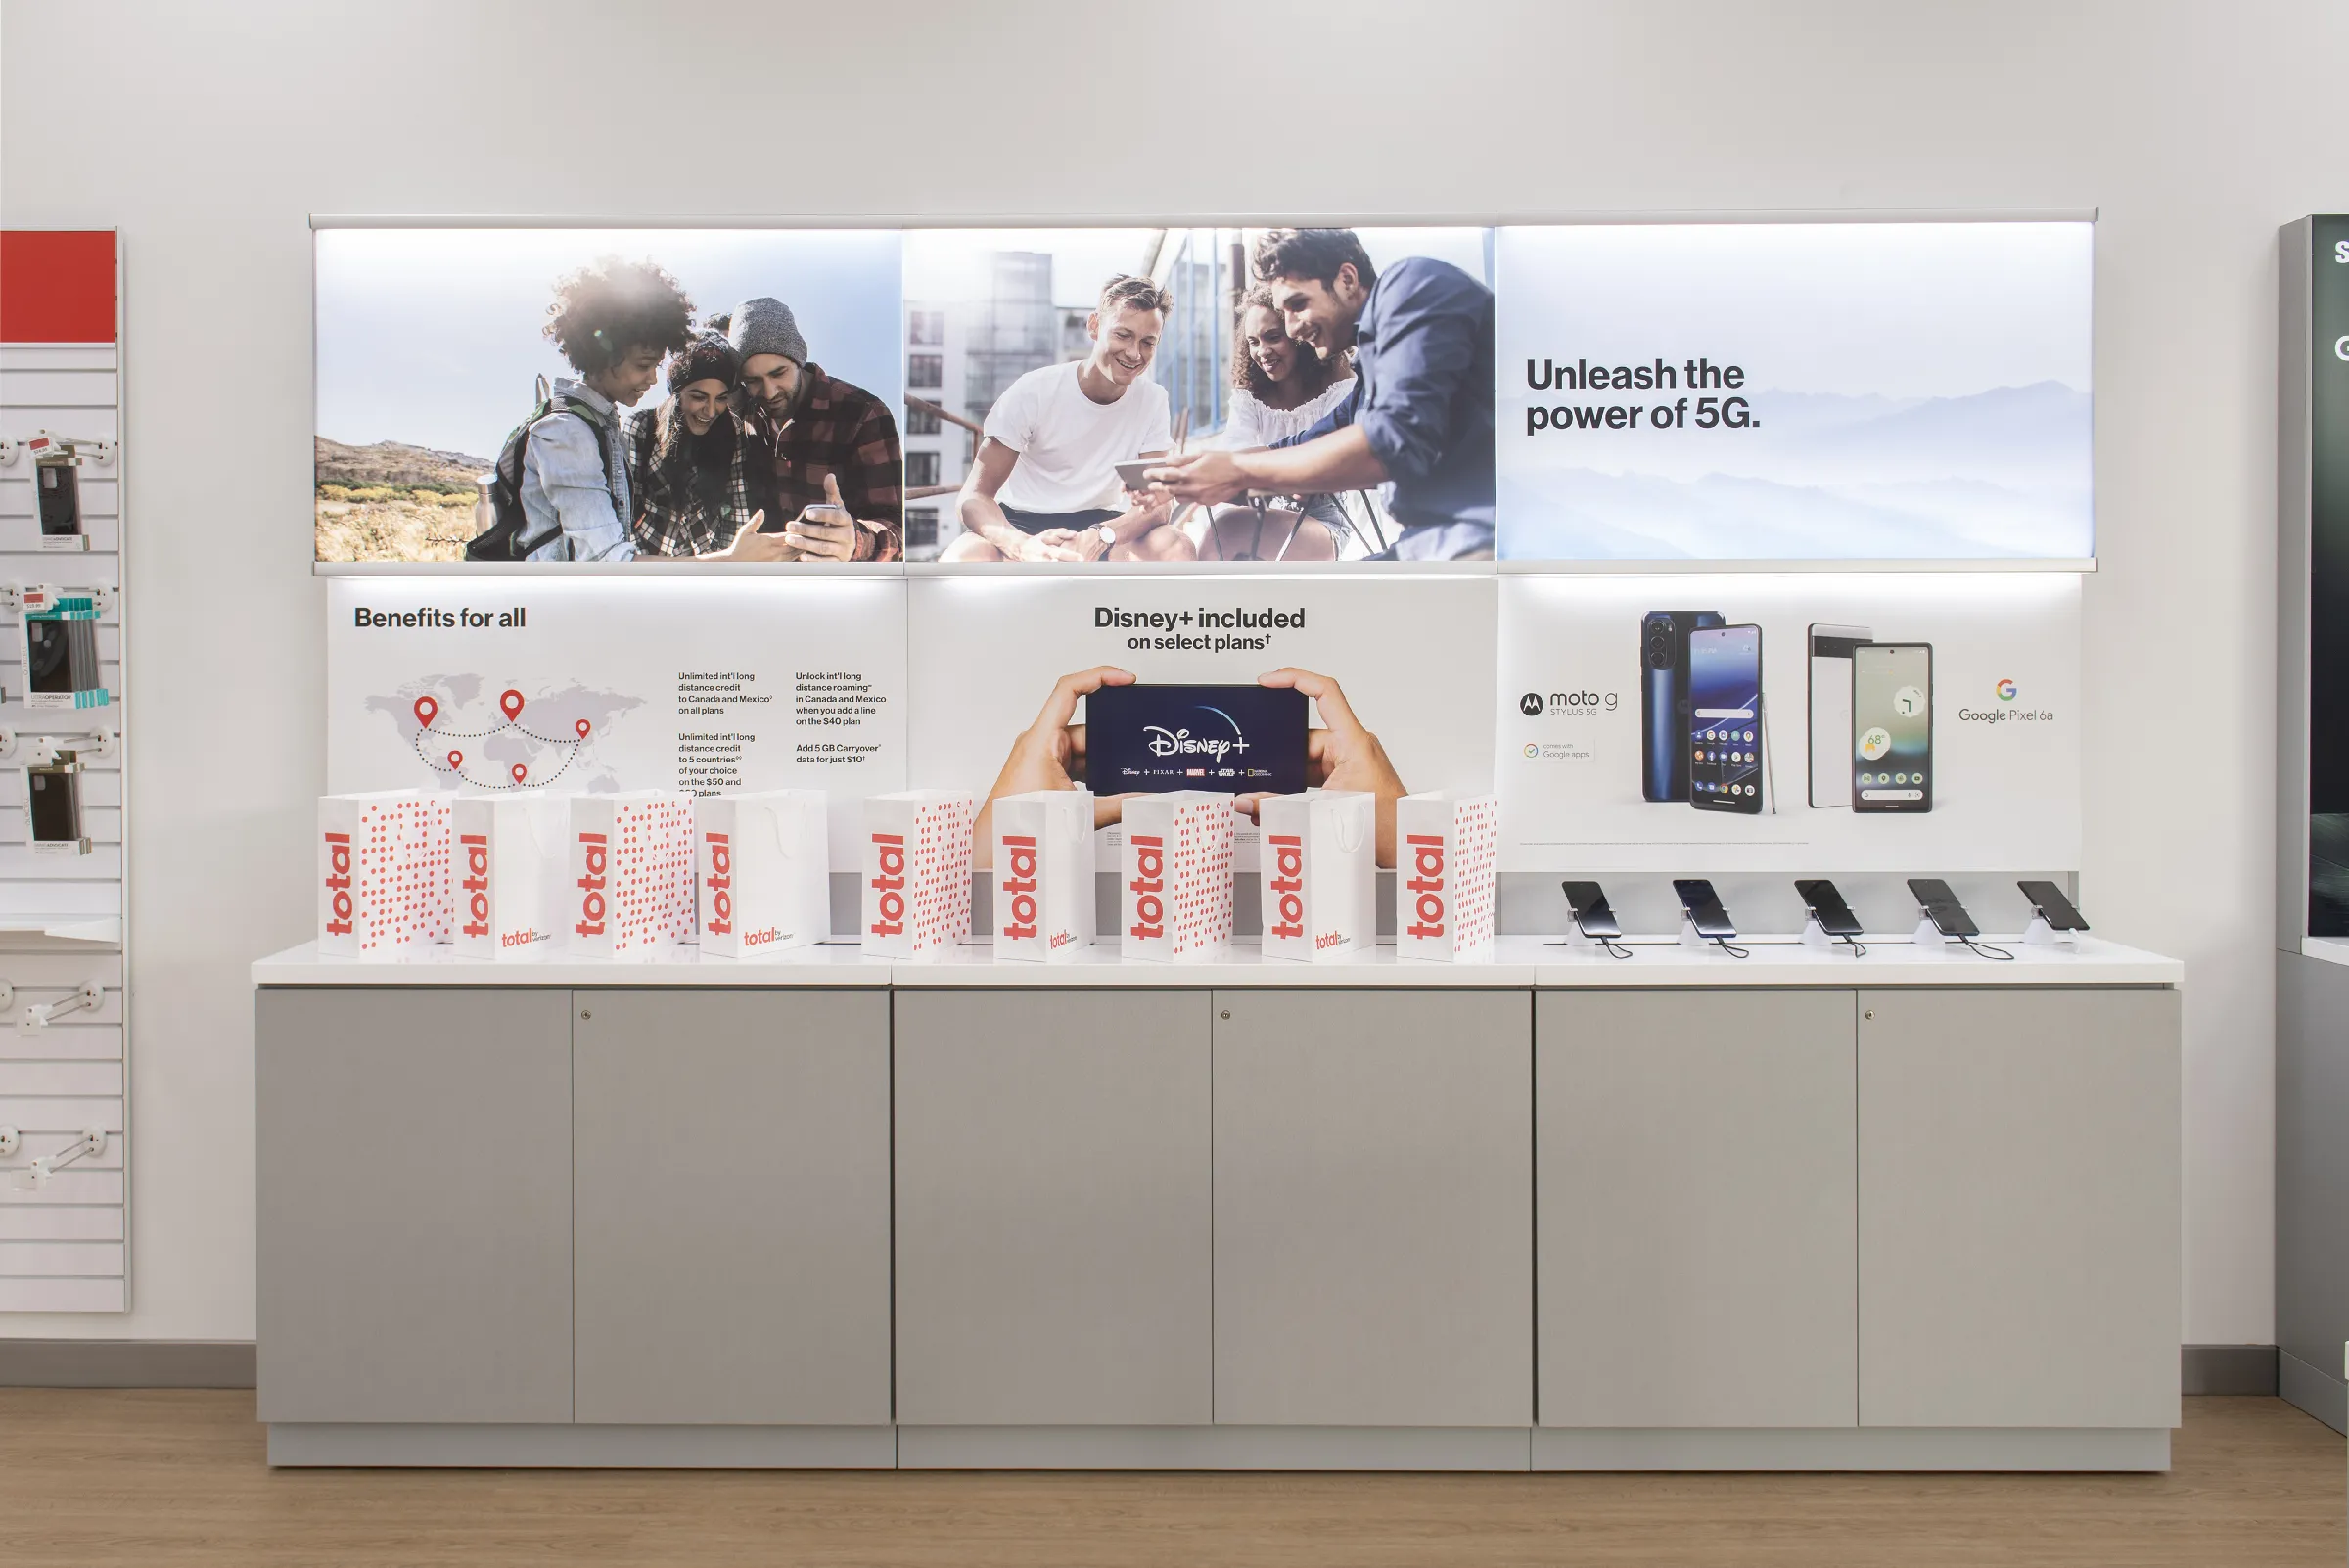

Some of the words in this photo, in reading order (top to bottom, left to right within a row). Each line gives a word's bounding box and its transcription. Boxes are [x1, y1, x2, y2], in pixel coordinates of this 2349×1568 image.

[1528, 358, 1676, 390] Unleash
[1684, 358, 1744, 389] the
[1528, 406, 1643, 436] power
[1651, 398, 1687, 429] of
[1695, 397, 1760, 428] 5G.
[355, 608, 455, 627] Benefits
[460, 608, 494, 627] for
[499, 608, 526, 627] all
[1095, 608, 1193, 632] Disney+
[1199, 608, 1305, 628] included
[1127, 637, 1150, 650] on
[1155, 634, 1211, 649] select
[678, 671, 718, 680] Unlimited
[719, 671, 734, 680] int'l
[736, 671, 755, 682] long
[795, 671, 825, 680] Unlock
[826, 671, 842, 680] int'l
[843, 671, 861, 682] long
[678, 683, 714, 692] distance
[715, 683, 740, 692] credit
[795, 683, 832, 692] distance
[1550, 690, 1599, 706] moto
[1605, 693, 1617, 711] g
[690, 706, 700, 715] all
[701, 706, 724, 715] plans
[795, 706, 818, 715] when
[837, 706, 852, 715] add
[860, 706, 875, 715] line
[1958, 708, 2006, 724] Google
[2009, 709, 2037, 721] Pixel
[2039, 710, 2053, 721] 6a
[807, 717, 821, 726] the
[822, 716, 841, 726] $40
[842, 717, 860, 727] plan
[678, 732, 718, 741] Unlimited
[719, 732, 735, 741] int'l
[736, 732, 755, 743] long
[678, 744, 714, 753] distance
[715, 743, 740, 753] credit
[796, 743, 813, 753] Add
[814, 743, 820, 753] 5
[821, 743, 835, 753] GB
[1543, 750, 1571, 759] Google
[688, 755, 694, 763] 5
[796, 755, 814, 763] data
[815, 755, 828, 763] for
[829, 755, 845, 764] just
[678, 766, 687, 775] of
[688, 767, 708, 776] your
[709, 766, 737, 775] choice
[1186, 768, 1206, 777] MARVEL
[690, 777, 704, 786] the
[706, 777, 723, 787] $50
[724, 777, 741, 786] and
[326, 833, 352, 935] total
[461, 835, 488, 938] total
[576, 833, 607, 937] total
[707, 832, 731, 935] total
[871, 834, 904, 937] total
[1002, 836, 1037, 940] total
[1130, 835, 1163, 940] total
[1268, 835, 1303, 939] total
[1407, 835, 1443, 939] total
[502, 928, 532, 947] total
[744, 927, 774, 945] total
[1050, 929, 1067, 949] total
[1316, 931, 1338, 949] total
